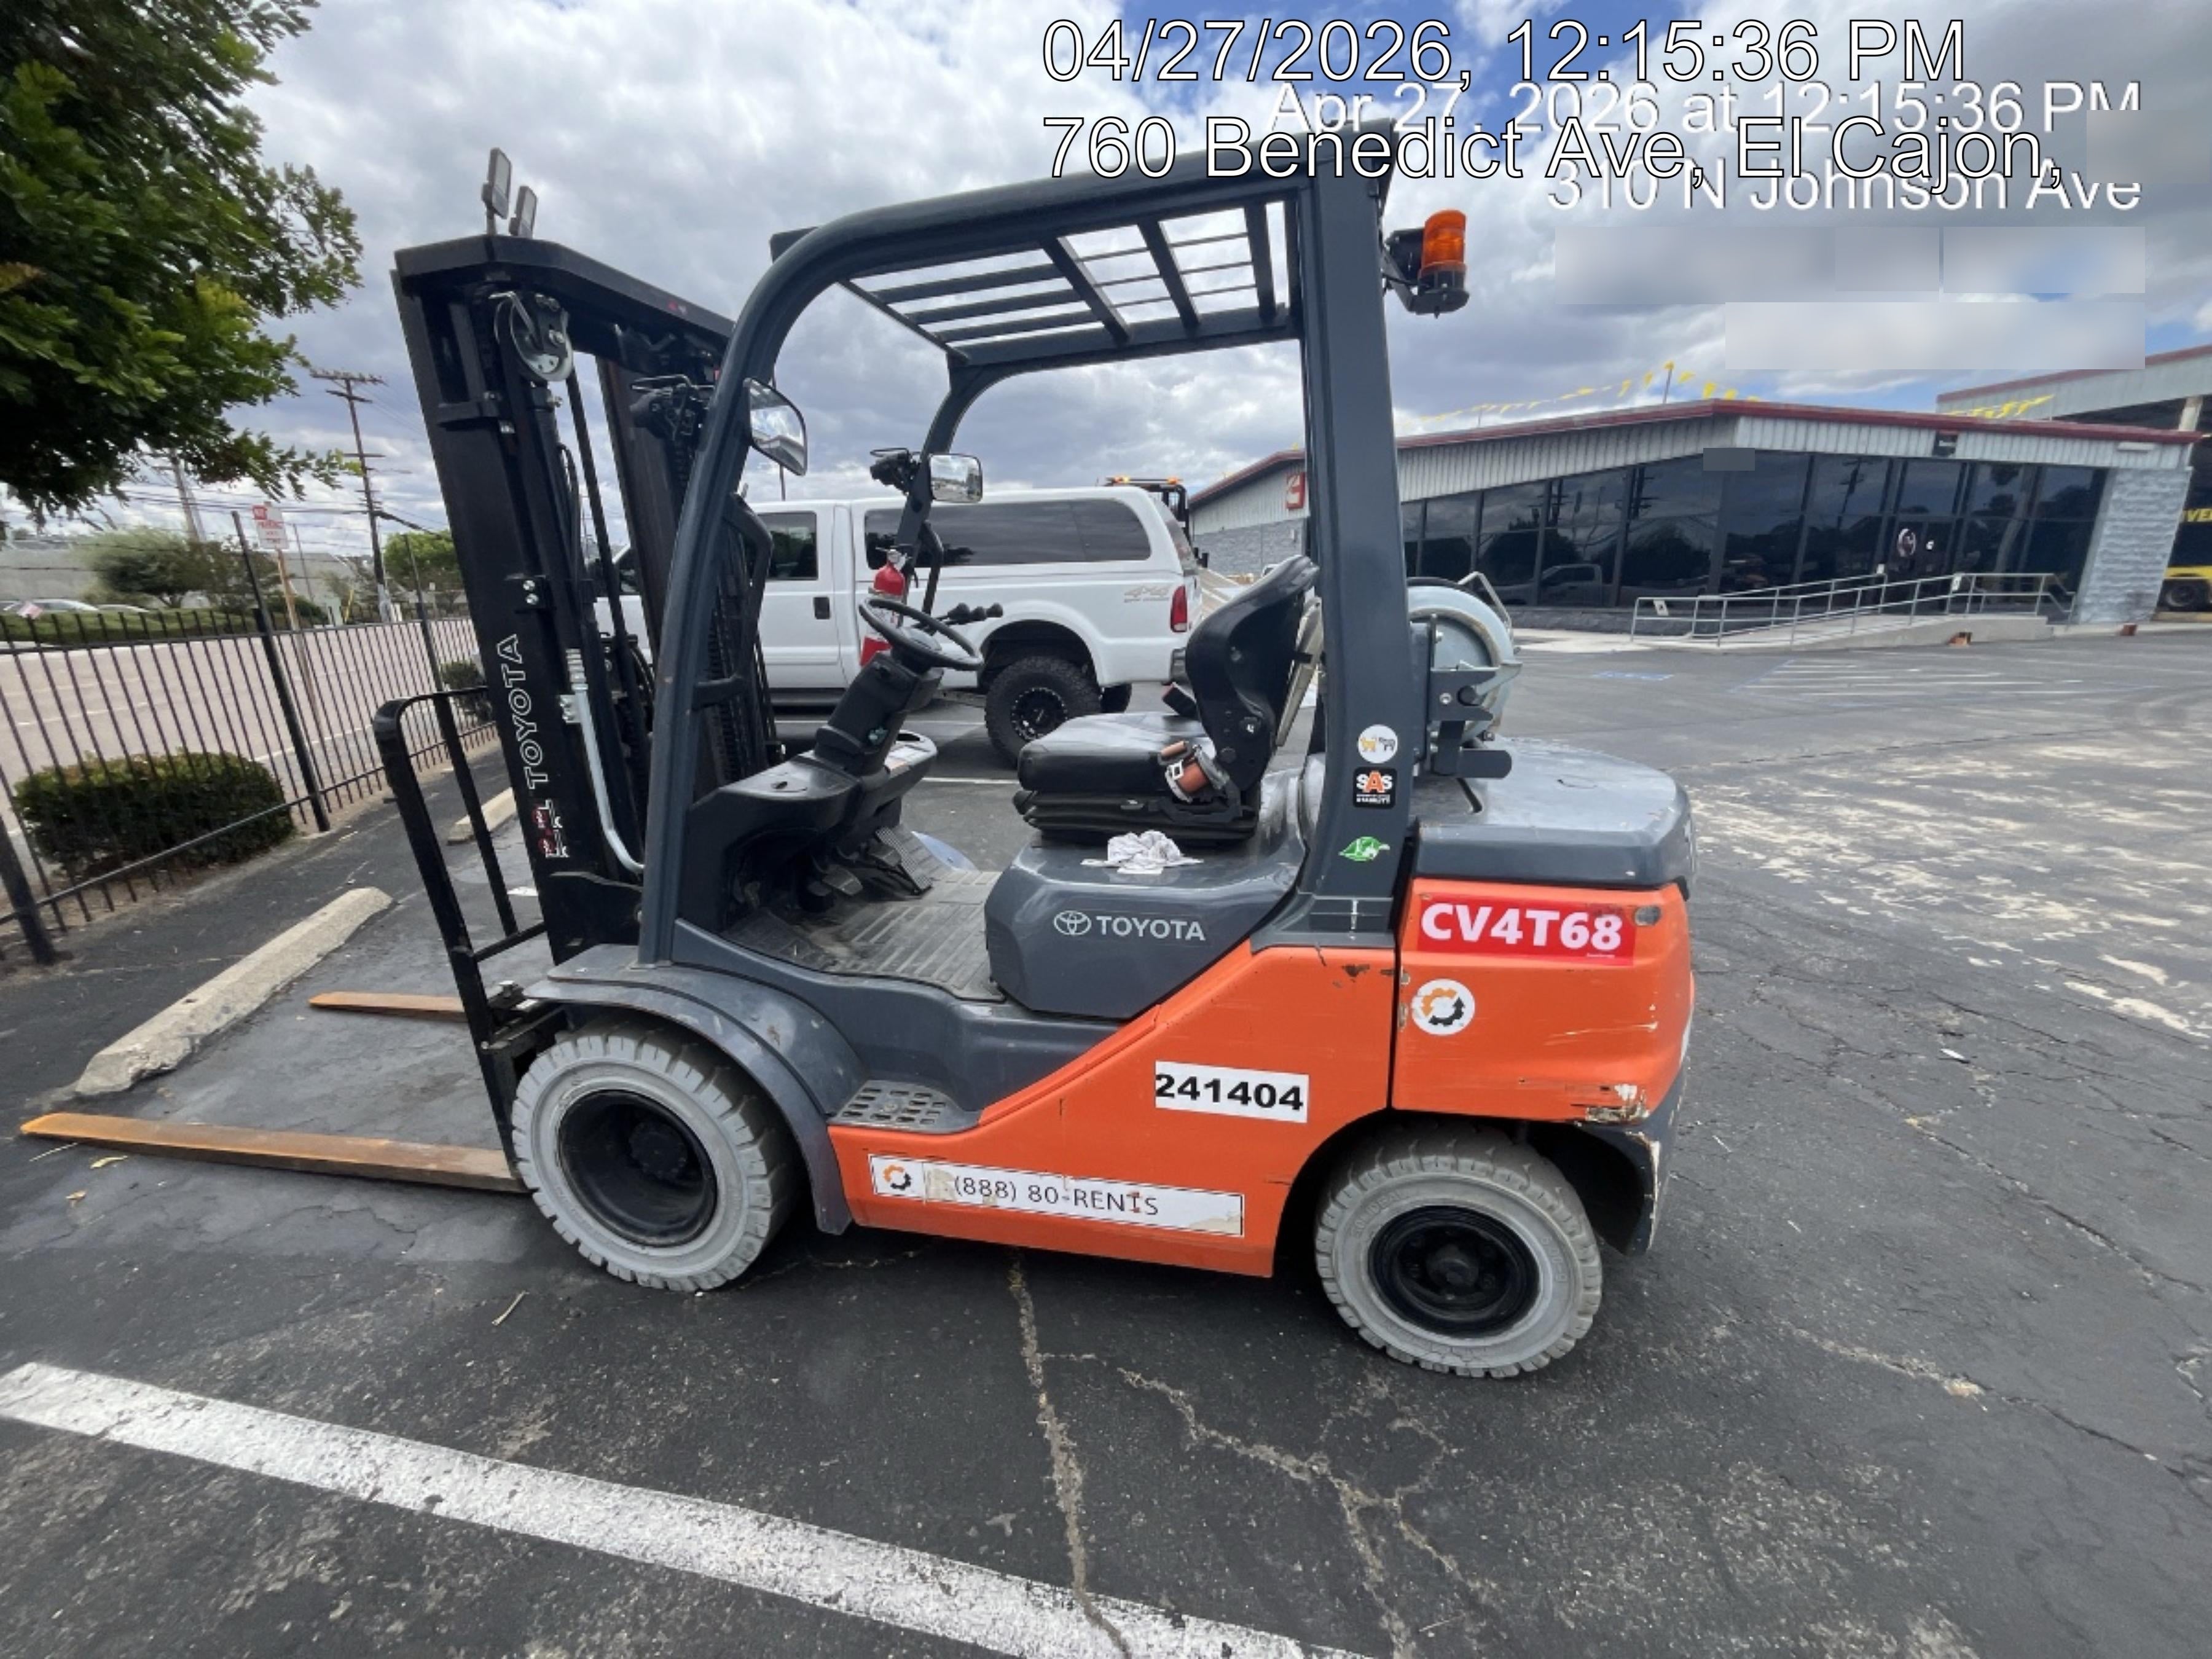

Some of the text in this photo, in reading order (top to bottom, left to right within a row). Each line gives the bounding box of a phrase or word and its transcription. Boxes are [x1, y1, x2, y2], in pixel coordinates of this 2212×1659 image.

[496, 633, 549, 790] TOYOTA
[1356, 770, 1393, 793] SAS
[1096, 915, 1206, 941] TOYOTA
[1420, 903, 1623, 951] CV4T68
[1155, 1073, 1304, 1111] 241404
[954, 1175, 1017, 1202] (888)
